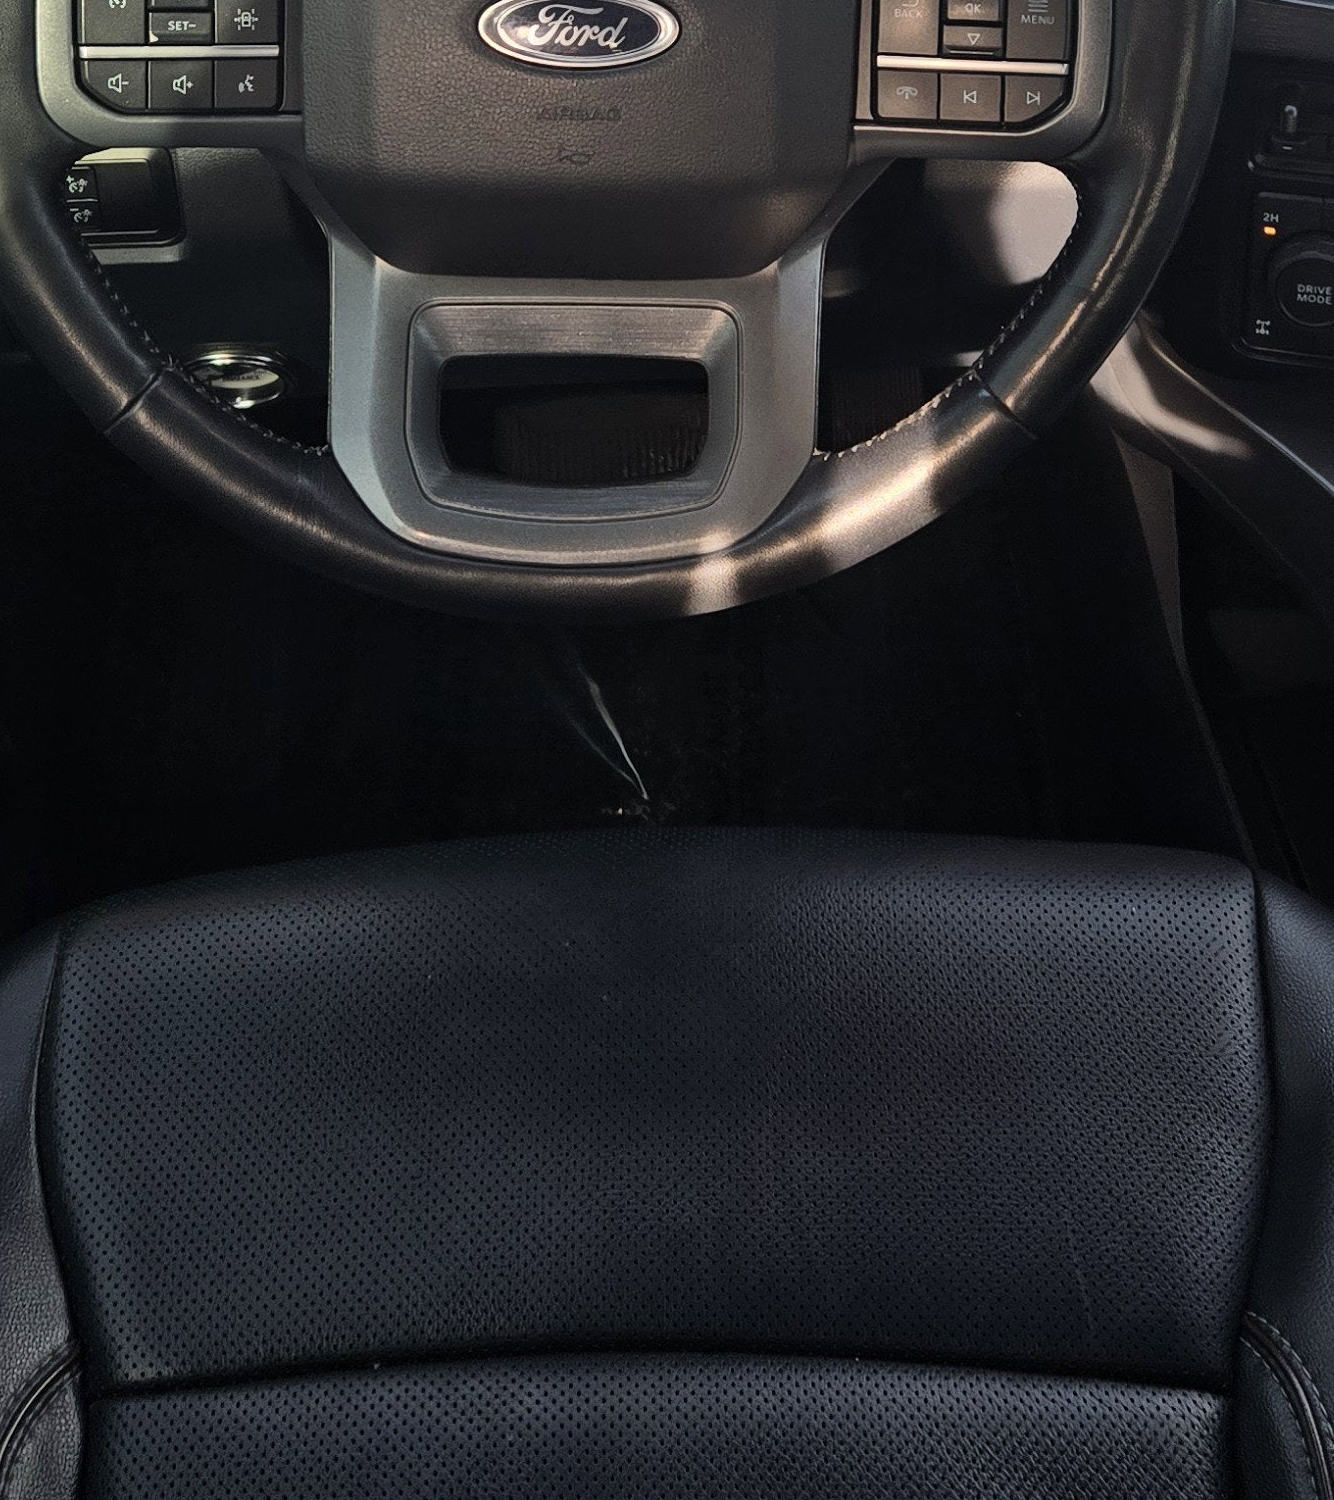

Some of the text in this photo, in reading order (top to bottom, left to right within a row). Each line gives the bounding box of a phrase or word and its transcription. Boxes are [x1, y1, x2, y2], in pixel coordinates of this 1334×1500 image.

[894, 8, 924, 19] BACK
[1020, 14, 1055, 26] MENU
[527, 3, 629, 52] Ford
[1263, 212, 1279, 223] 2H
[1297, 283, 1333, 296] DRIVE
[1296, 293, 1332, 305] MODE
